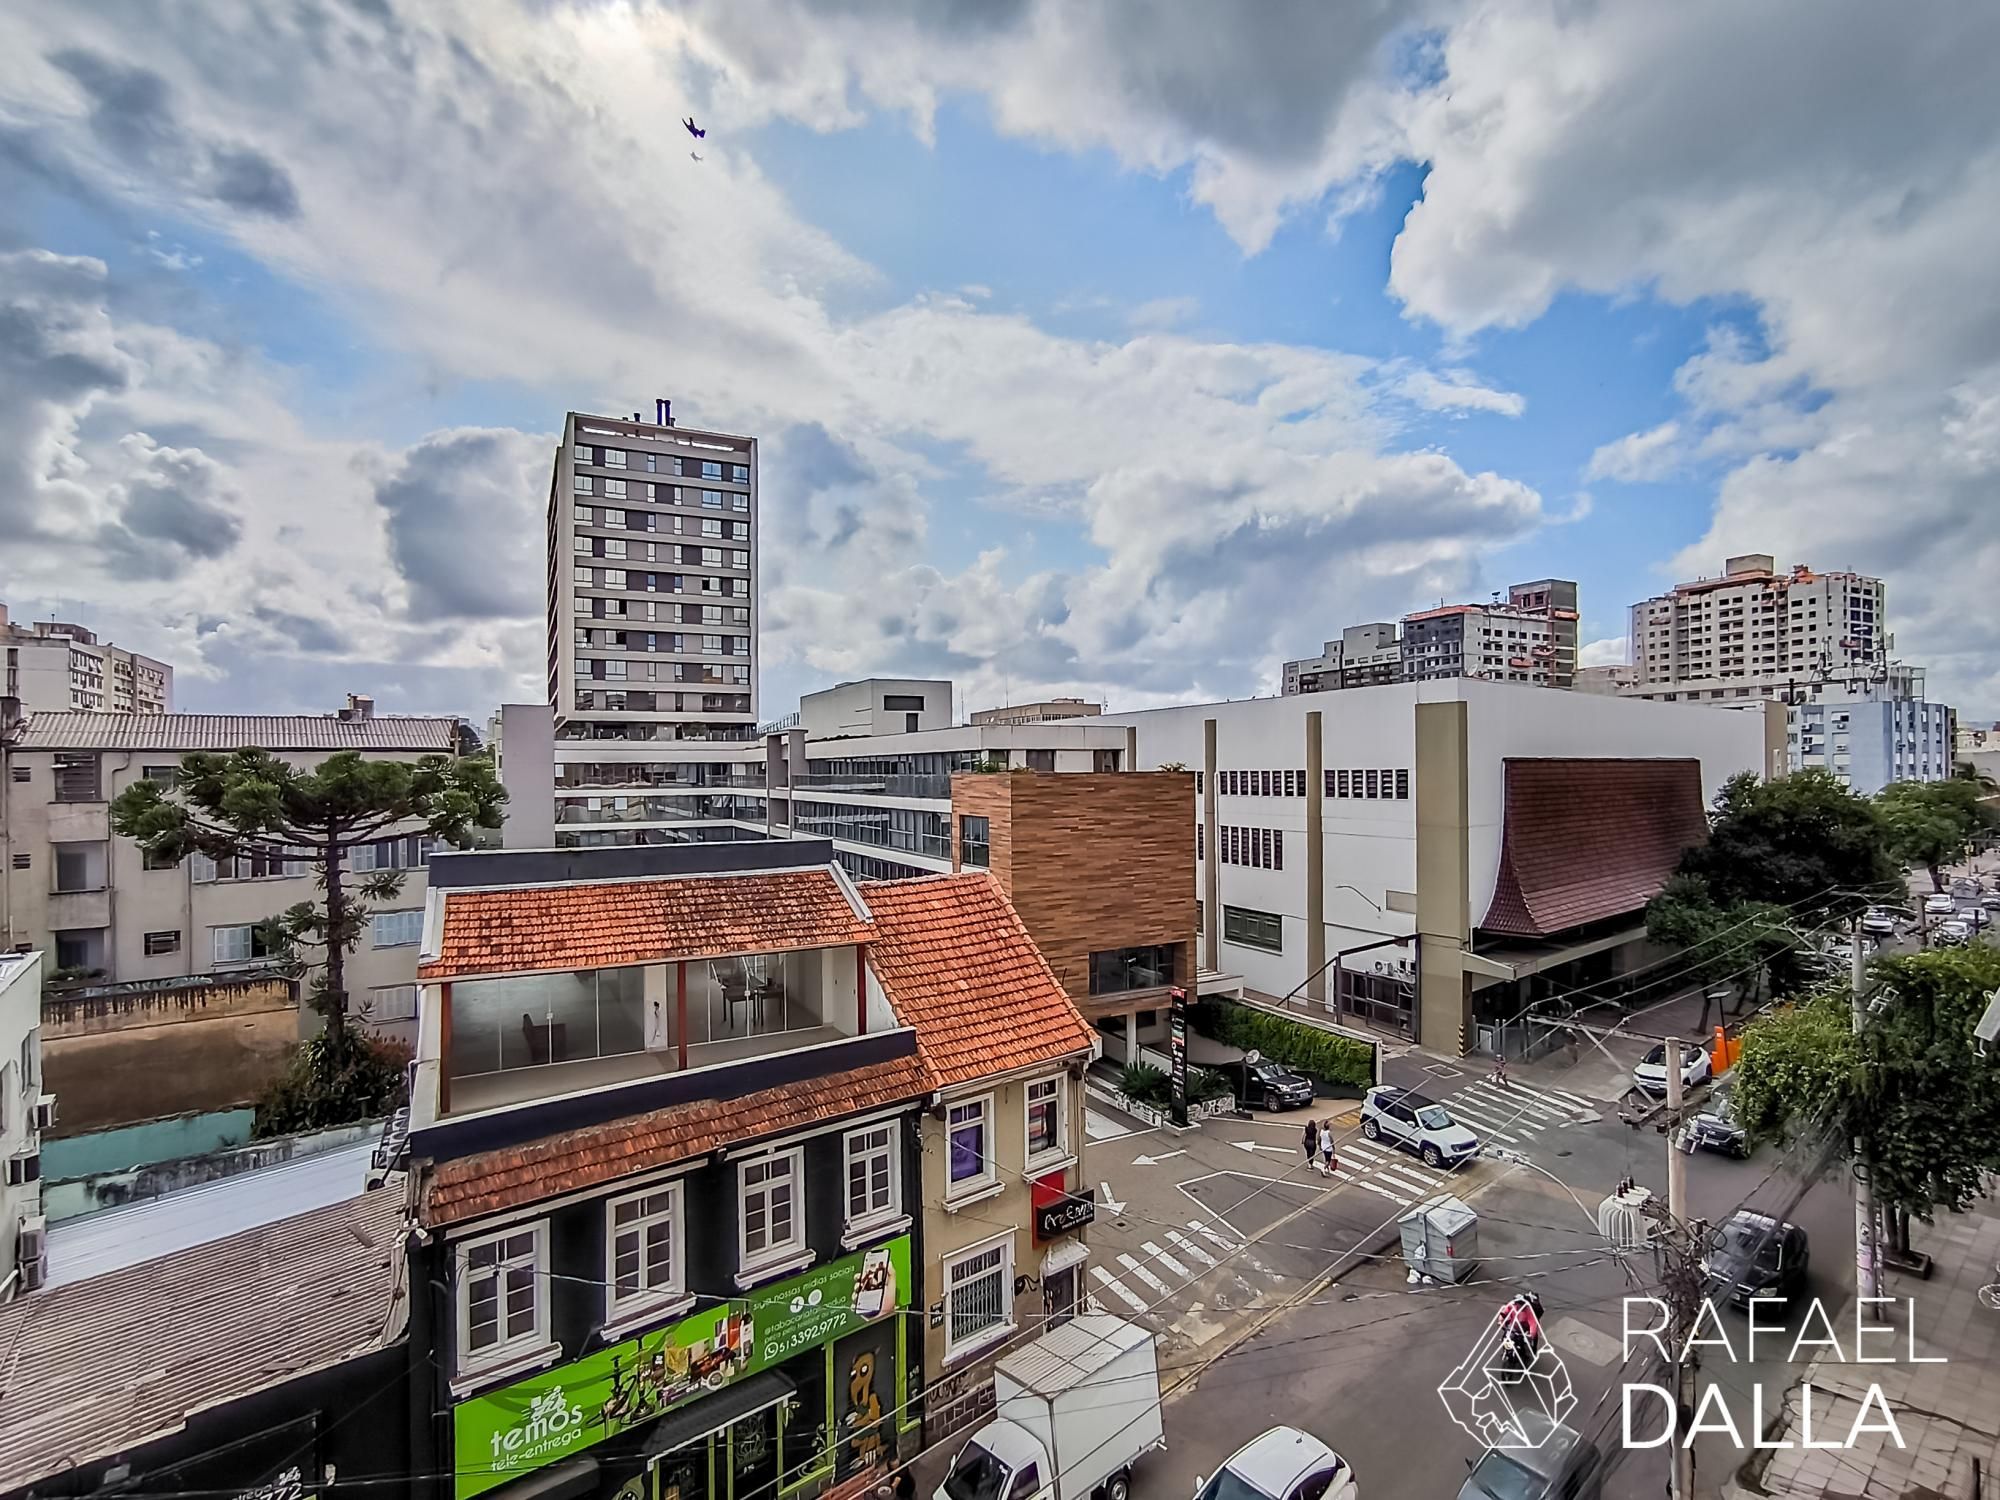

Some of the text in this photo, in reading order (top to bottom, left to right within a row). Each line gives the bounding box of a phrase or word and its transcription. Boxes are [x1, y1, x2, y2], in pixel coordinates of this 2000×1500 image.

[774, 1287, 801, 1301] nossas
[829, 1265, 855, 1281] sociais
[779, 1340, 790, 1353] 51
[790, 1312, 847, 1347] 3392.9772
[491, 1405, 583, 1457] temos
[491, 1428, 582, 1472] tele-entrega
